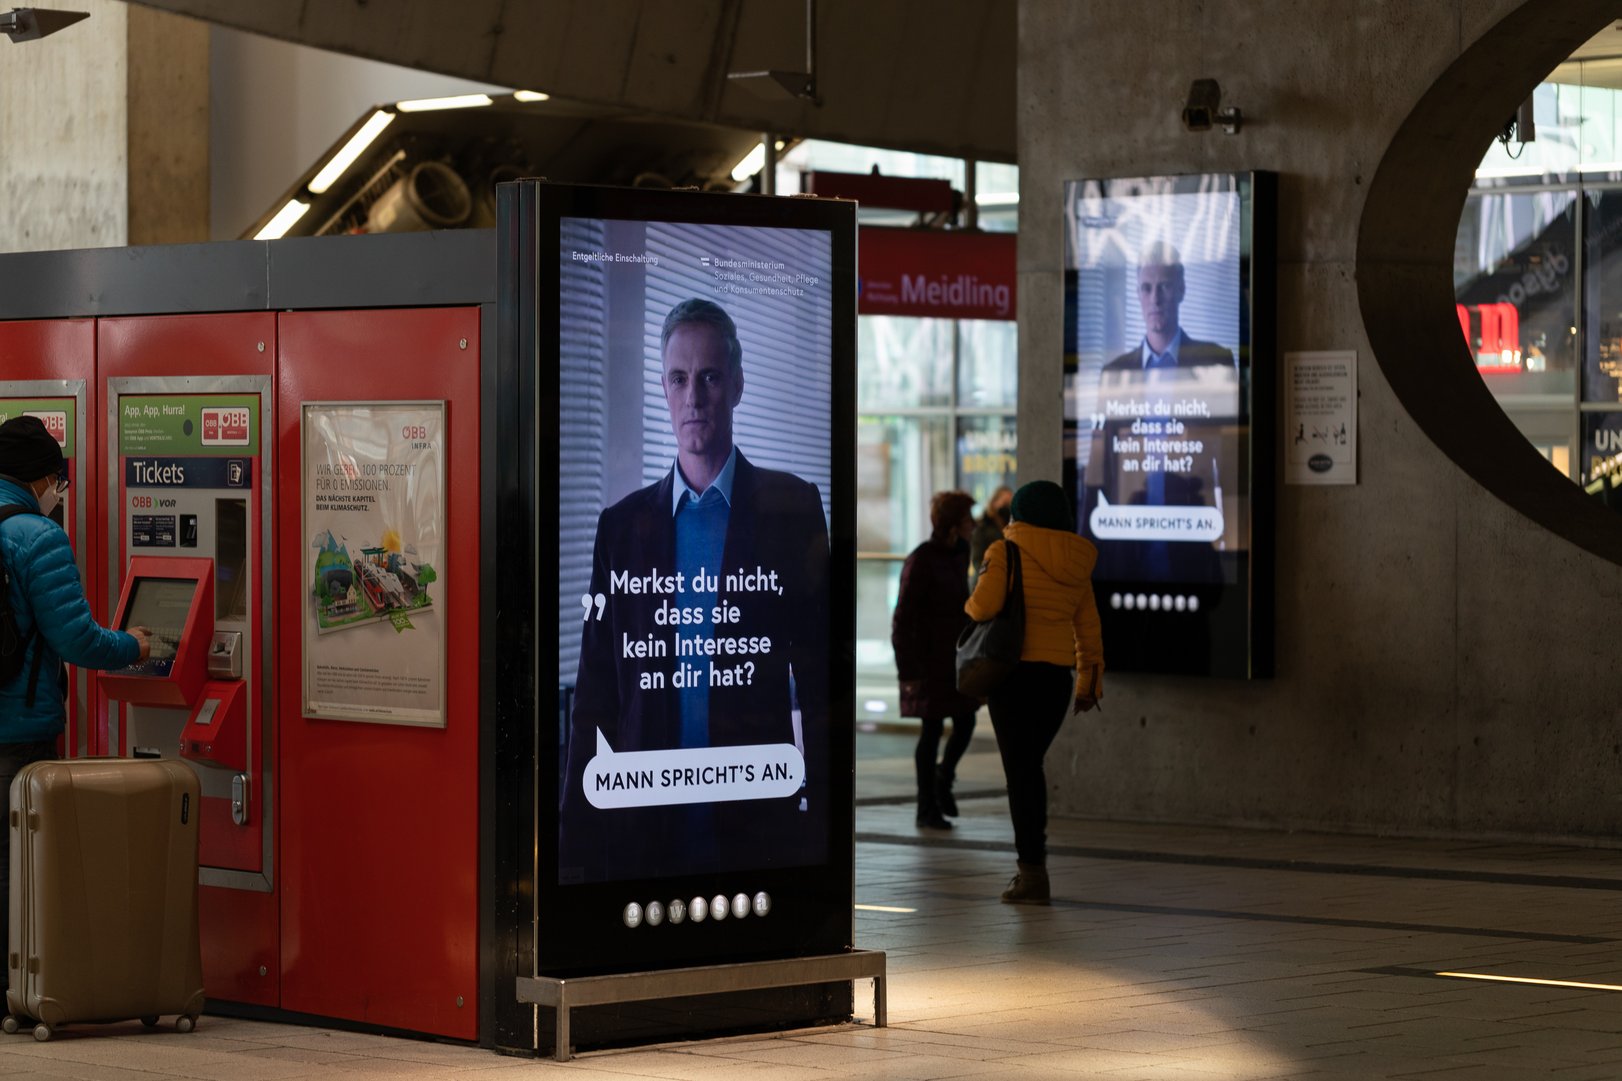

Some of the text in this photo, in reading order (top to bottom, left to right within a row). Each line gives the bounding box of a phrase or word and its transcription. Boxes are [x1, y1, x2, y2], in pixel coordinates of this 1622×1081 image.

[572, 251, 659, 267] Entgeltliche Einschaltung
[714, 257, 785, 270] Bundesministerium
[714, 271, 819, 286] Soziales, Gesundheit, Pflege
[714, 284, 804, 296] und Konsumentenschutz
[900, 273, 1010, 316] Meidling
[125, 404, 185, 418] App, App, Hurra!
[1106, 399, 1211, 418] Merkst du nicht,
[1131, 419, 1184, 435] dass sie
[411, 442, 432, 450] INFRA
[1113, 436, 1203, 453] kein Interesse
[316, 464, 331, 475] WIR
[363, 464, 376, 476] 100
[380, 464, 416, 476] PROZENT
[1123, 456, 1193, 472] an dir hat?
[133, 461, 184, 484] Tickets
[316, 477, 331, 490] FÜR
[333, 479, 338, 490] 0
[159, 499, 176, 508] VOR
[328, 493, 351, 502] NÄCHSTE
[353, 495, 375, 503] KAPITEL
[330, 504, 370, 512] KLIMASCHUTZ.
[1098, 517, 1216, 531] MANN SPRICHT'S AN.
[610, 566, 784, 596] Merkst du nicht,
[654, 599, 741, 625] dass sie
[623, 632, 771, 658] kein Interesse
[639, 661, 755, 690] an dir hat?
[596, 763, 793, 791] MANN SPRICHT'S AN.
[623, 892, 771, 928] gewista
